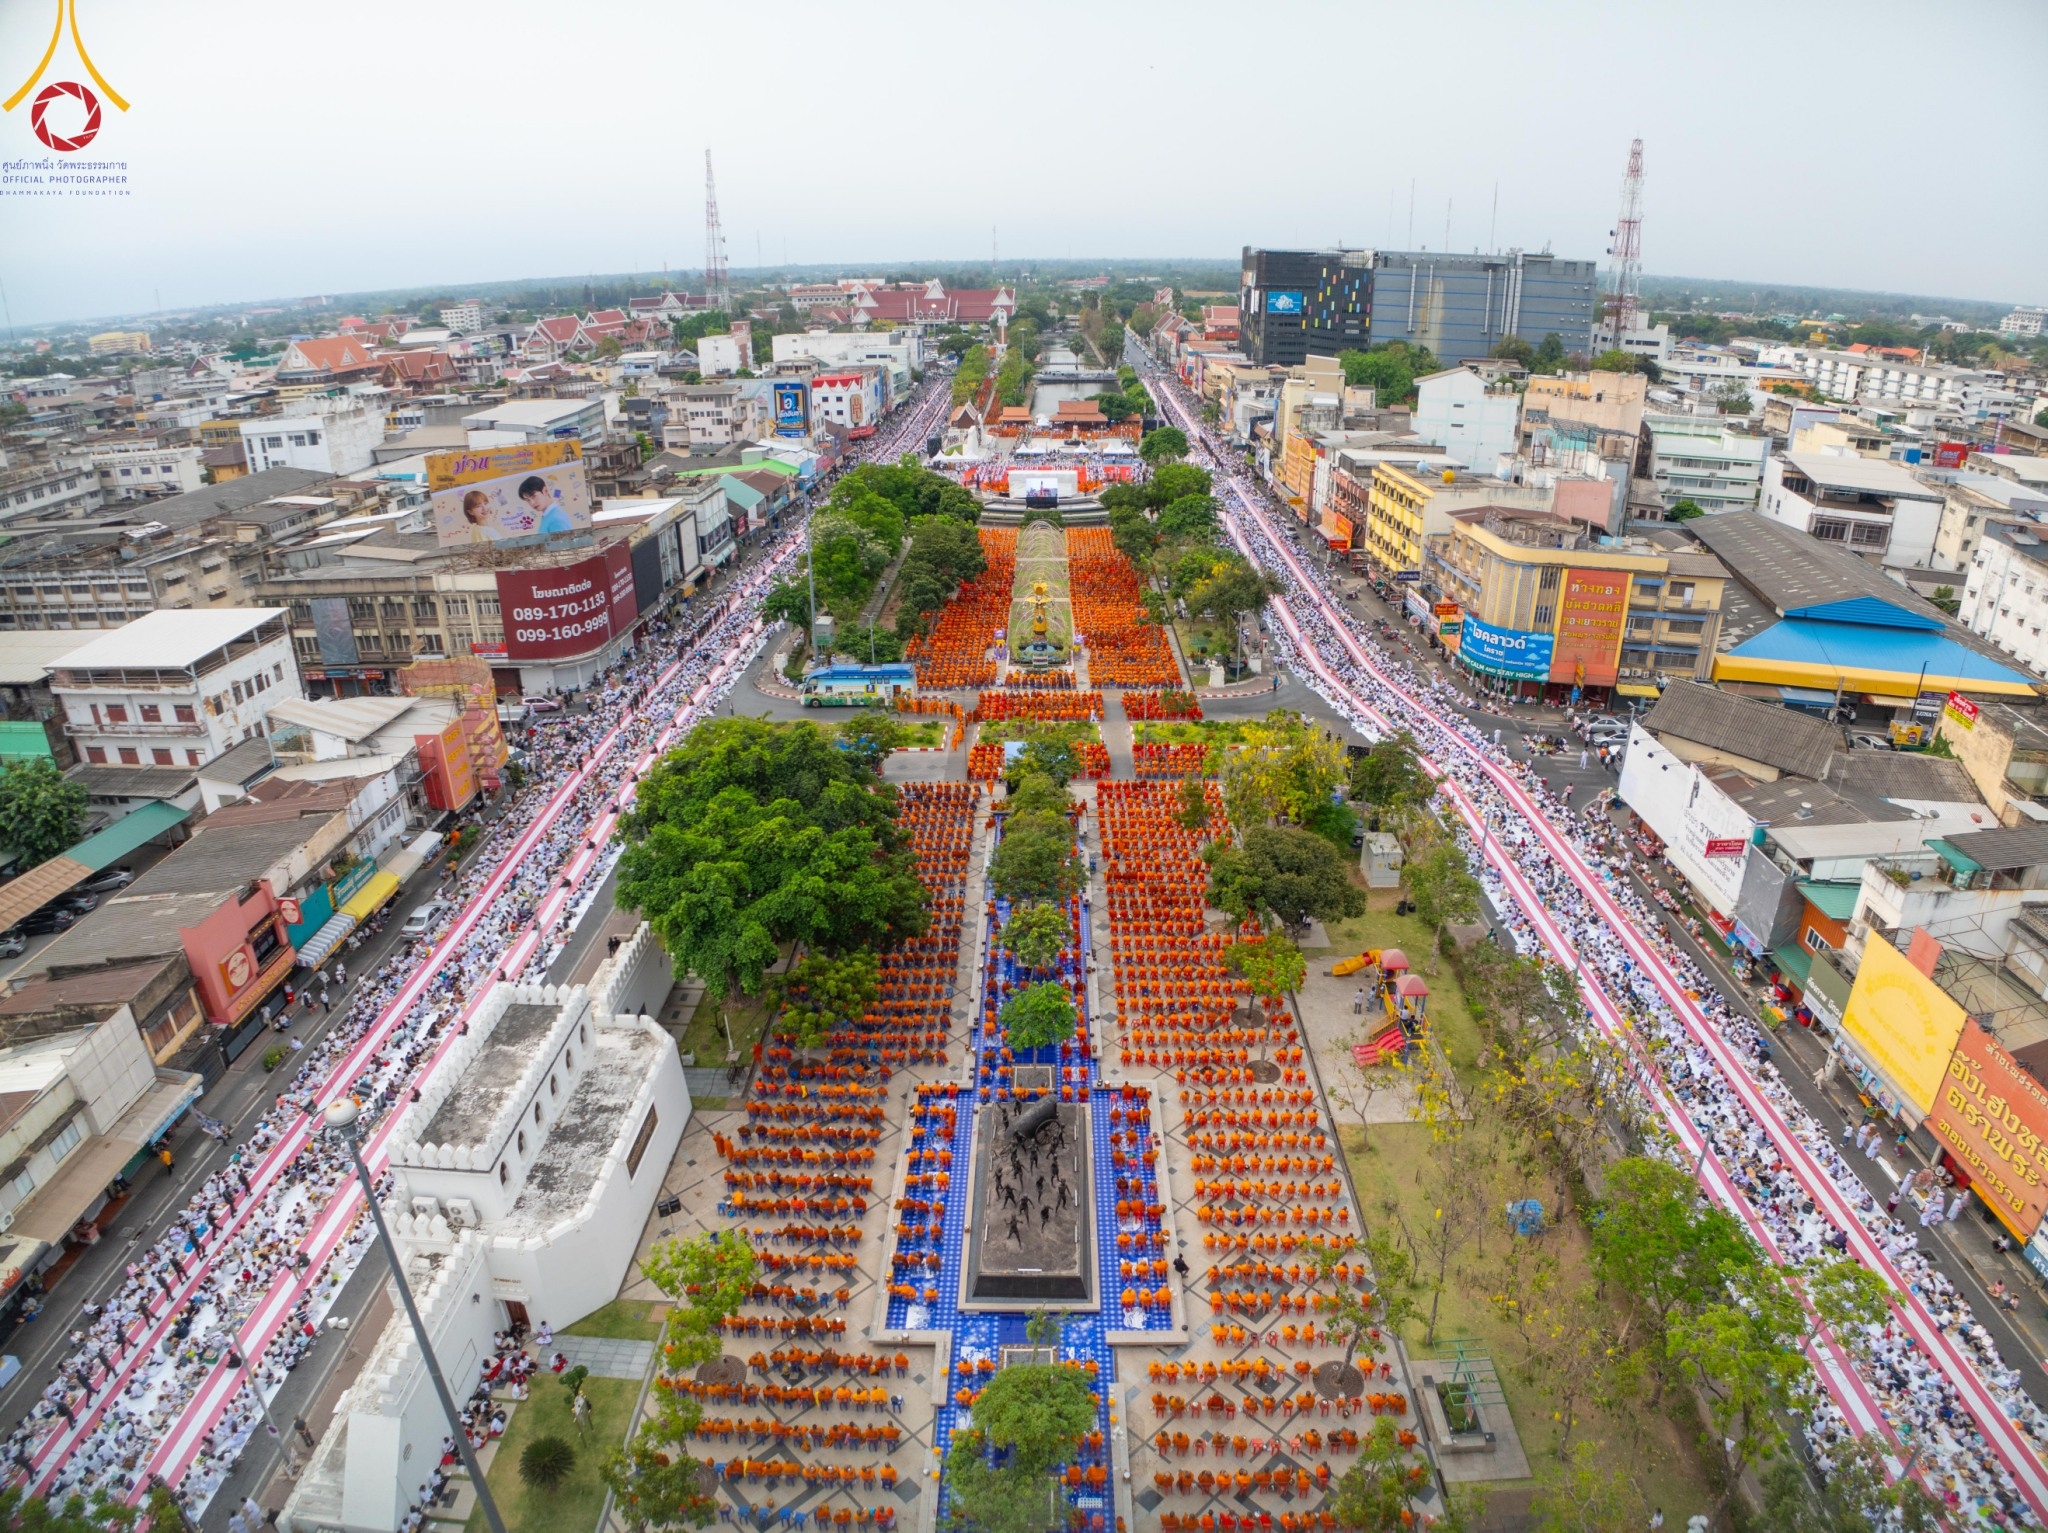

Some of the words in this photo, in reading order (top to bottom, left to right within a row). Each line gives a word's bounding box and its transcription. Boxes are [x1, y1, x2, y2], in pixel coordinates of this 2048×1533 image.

[531, 578, 592, 599] โฆษณาติดต่อ
[1571, 579, 1620, 595] ห้างทอง
[513, 591, 606, 621] 089-170-1133
[516, 611, 608, 642] 099-160-9999
[1483, 644, 1504, 656] โคราช
[1471, 660, 1485, 670] CALM
[1485, 665, 1497, 673] AND
[1497, 669, 1514, 677] STAY
[1515, 671, 1534, 679] HIGH
[1946, 1085, 2041, 1187] ตราพระ
[1937, 1118, 2025, 1213] ทองเยาวราช
